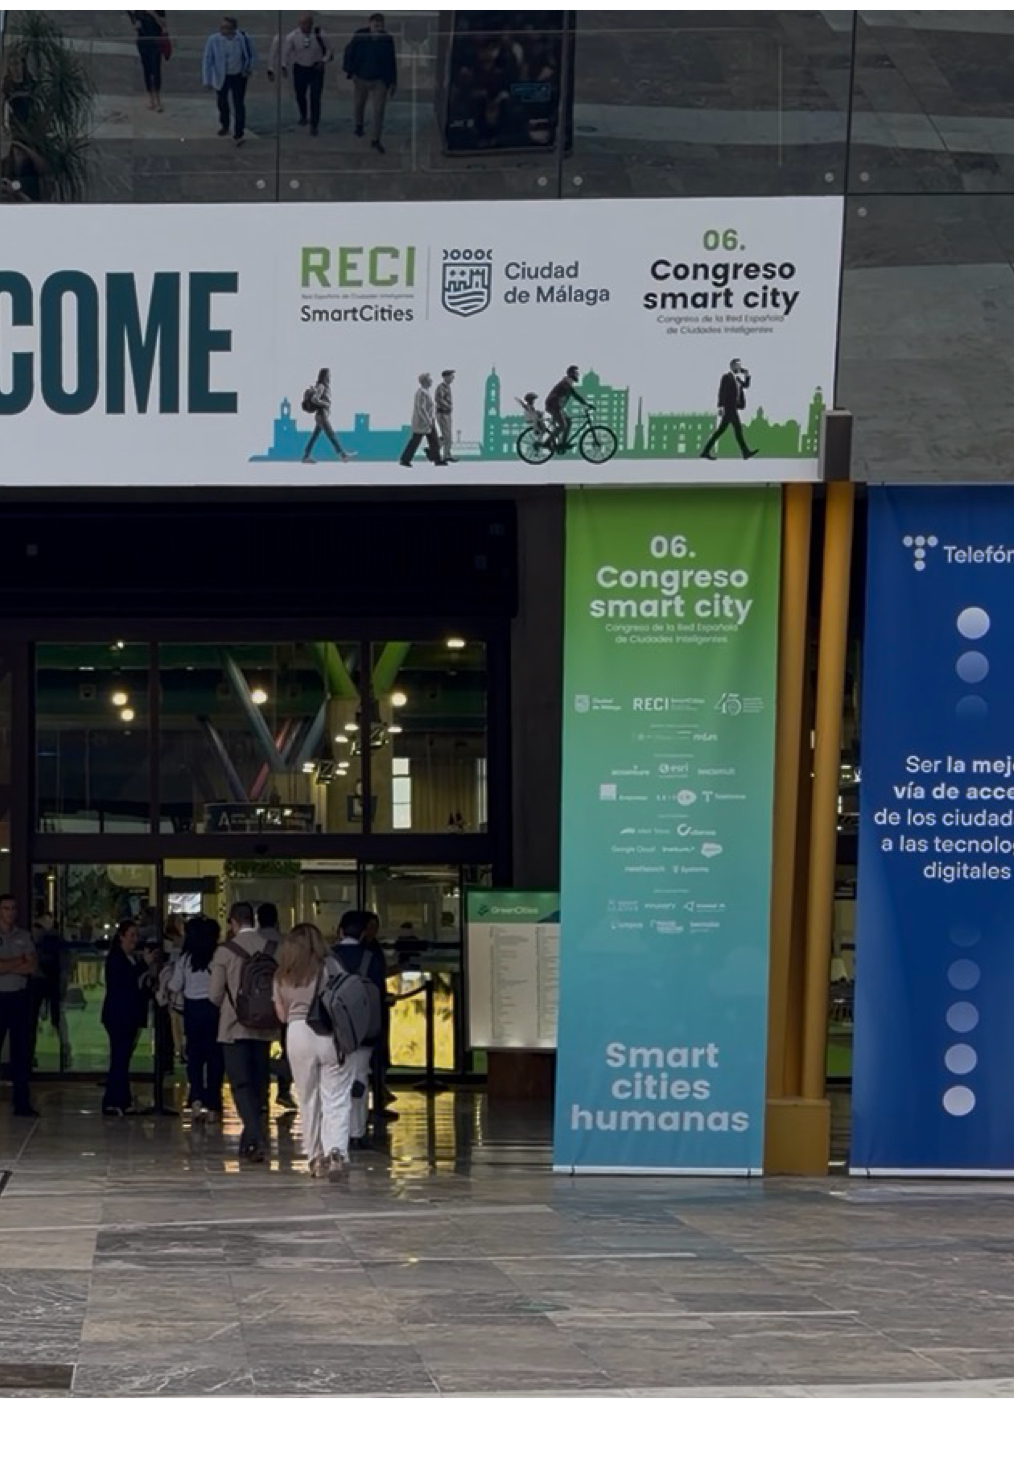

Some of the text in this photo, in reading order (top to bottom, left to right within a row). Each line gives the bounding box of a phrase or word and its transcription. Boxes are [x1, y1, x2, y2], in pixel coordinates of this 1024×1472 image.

[703, 228, 746, 251] 06.
[301, 246, 416, 287] RECI
[504, 261, 579, 280] Ciudad
[650, 259, 796, 288] Congreso
[504, 285, 610, 306] de Málaga
[643, 285, 800, 316] smart city
[300, 304, 414, 322] SmartCities
[650, 534, 696, 558] 06.
[596, 566, 750, 596] Congreso
[589, 592, 754, 625] smart city
[632, 697, 670, 711] RECI
[906, 755, 1014, 778] Ser la mej
[893, 781, 926, 799] vía
[932, 782, 960, 799] de
[874, 808, 1013, 826] de los ciudad
[881, 834, 1014, 854] a las tecnolo
[923, 862, 1012, 883] digitales
[606, 1042, 719, 1068] Smart
[611, 1071, 711, 1100] cities
[571, 1104, 750, 1131] humanas
